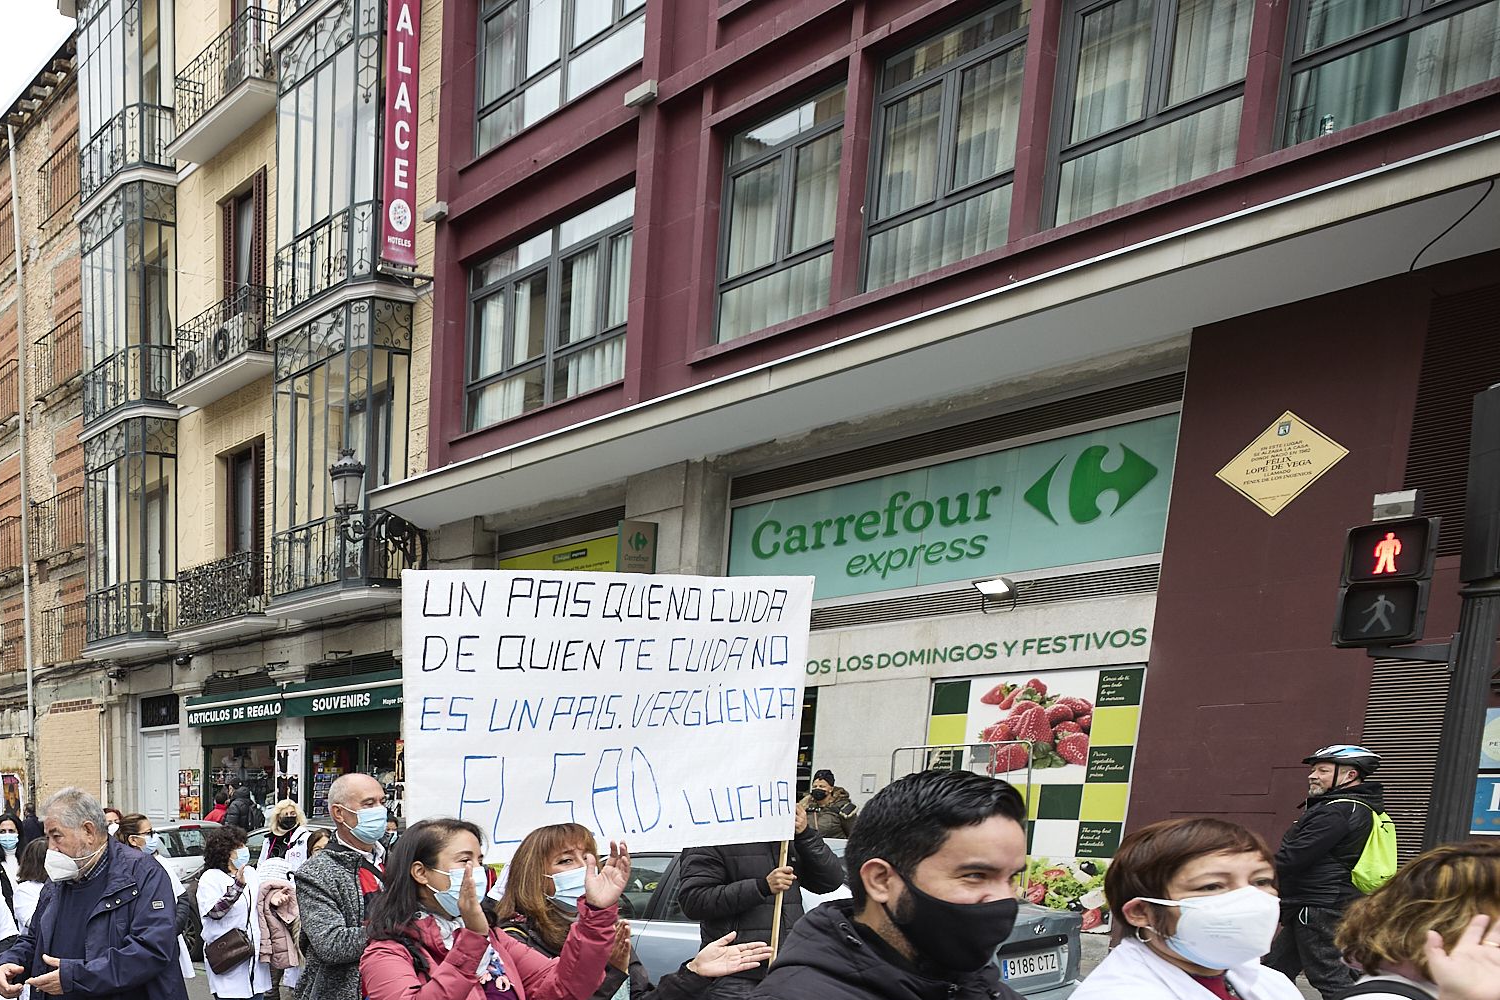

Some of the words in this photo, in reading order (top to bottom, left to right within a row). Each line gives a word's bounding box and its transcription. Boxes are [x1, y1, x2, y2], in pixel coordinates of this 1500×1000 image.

[387, 235, 411, 248] HOTELES
[1246, 466, 1268, 475] LOPE
[1271, 463, 1283, 471] DE
[1287, 459, 1312, 468] VEGA
[1264, 469, 1291, 477] LLAMADO
[752, 485, 1002, 561] Carrefour
[846, 534, 989, 579] express
[422, 580, 487, 618] UN
[506, 577, 596, 618] PAIS
[710, 588, 788, 623] CUIDA
[422, 635, 480, 672] DE
[498, 635, 606, 673] QUIEN
[614, 638, 656, 671] TE
[805, 659, 831, 675] OS
[836, 655, 874, 673] LOS
[876, 641, 998, 670] DOMINGOS
[1002, 640, 1019, 658] Y
[1022, 627, 1148, 657] FESTIVOS
[188, 708, 230, 725] ARTICULOS
[232, 708, 244, 720] DE
[247, 702, 282, 719] REGALO
[312, 692, 371, 712] SOUVENIRS
[420, 696, 474, 732] ES
[488, 697, 544, 732] UN
[631, 683, 796, 728] VERGÜENZA
[682, 780, 792, 825] LUCHA
[1009, 957, 1035, 976] 9186
[1037, 953, 1057, 971] CTZ
